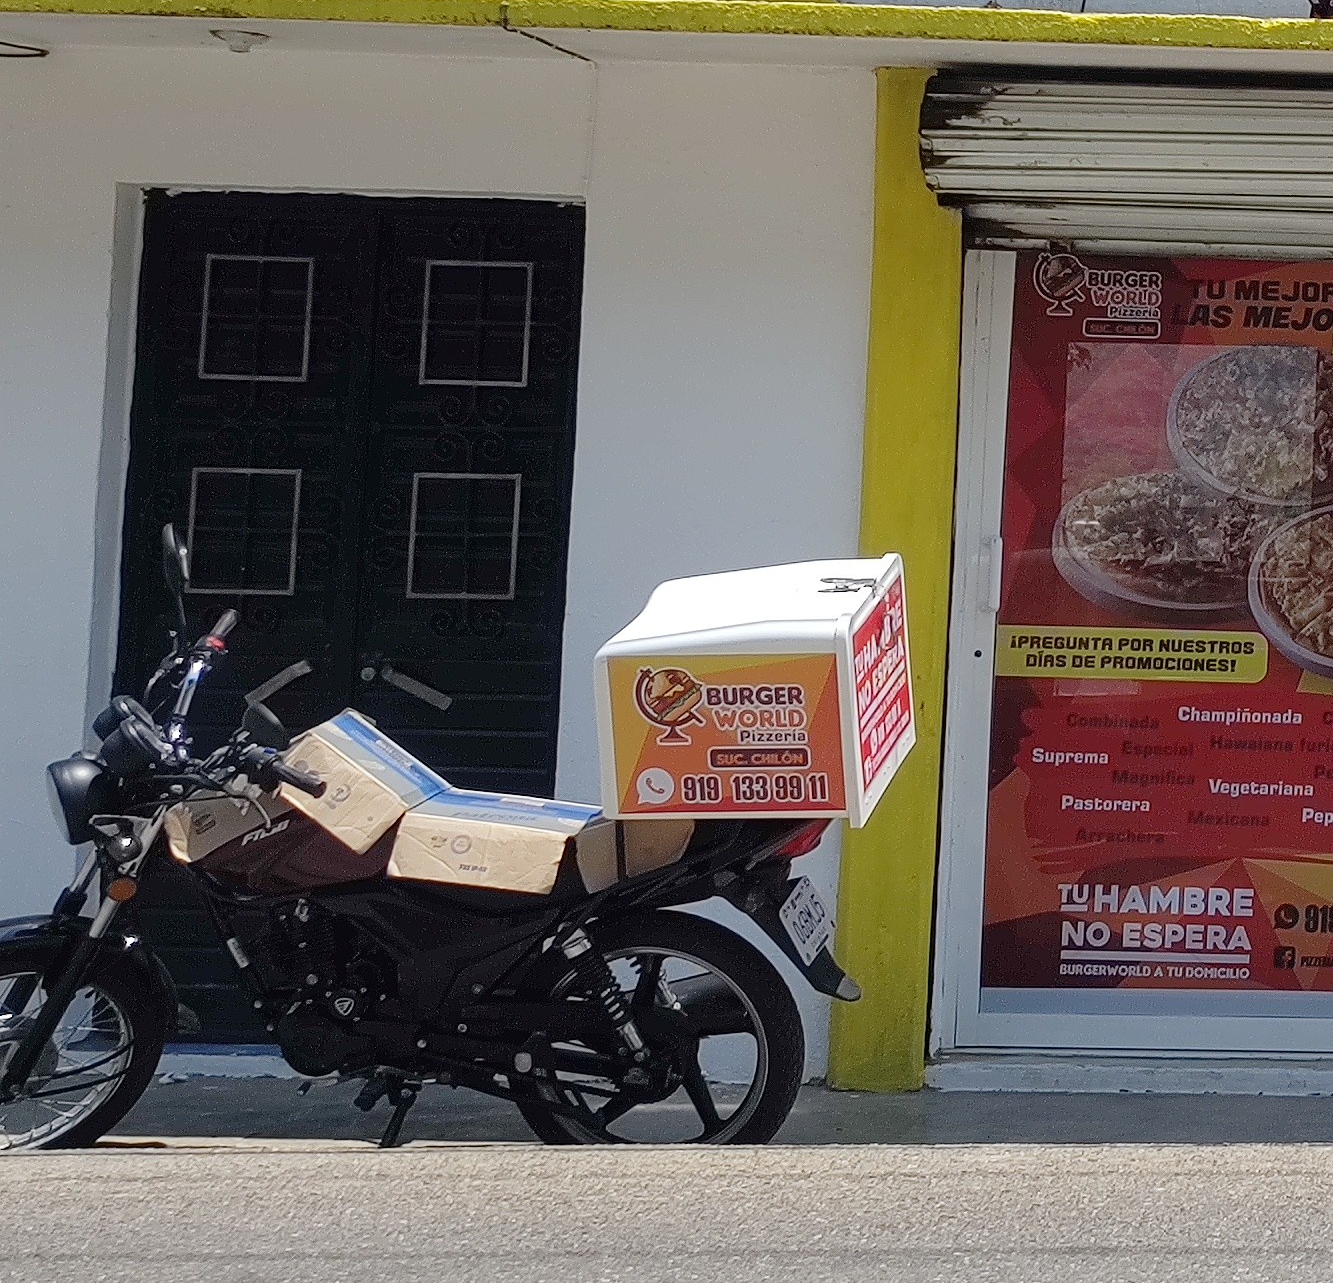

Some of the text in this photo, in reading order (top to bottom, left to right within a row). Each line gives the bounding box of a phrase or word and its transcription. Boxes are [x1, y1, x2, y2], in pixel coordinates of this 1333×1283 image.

[1087, 271, 1160, 288] BURGER
[1190, 279, 1226, 300] TU
[1092, 289, 1160, 306] WORLD
[1170, 304, 1234, 329] LAS
[1010, 635, 1255, 655] ¡PREGUNTA POR NUESTROS
[1025, 650, 1237, 673] DÍAS DE PROMOCIONES!
[706, 686, 803, 706] BURGER
[714, 708, 805, 728] WORLD
[1177, 706, 1303, 726] Champiñonada
[740, 729, 806, 742] Pizzería
[716, 753, 748, 765] SUC.
[1032, 747, 1110, 767] Suprema
[683, 775, 827, 802] 919 133 99 11
[1208, 778, 1315, 799] Vegetariana
[1060, 794, 1151, 813] Pastorera
[1058, 883, 1255, 917] TU HAMBRE
[1061, 920, 1252, 952] NO ESPERA
[1059, 963, 1251, 980] BURGERWORLD A TU DOMICILIO
